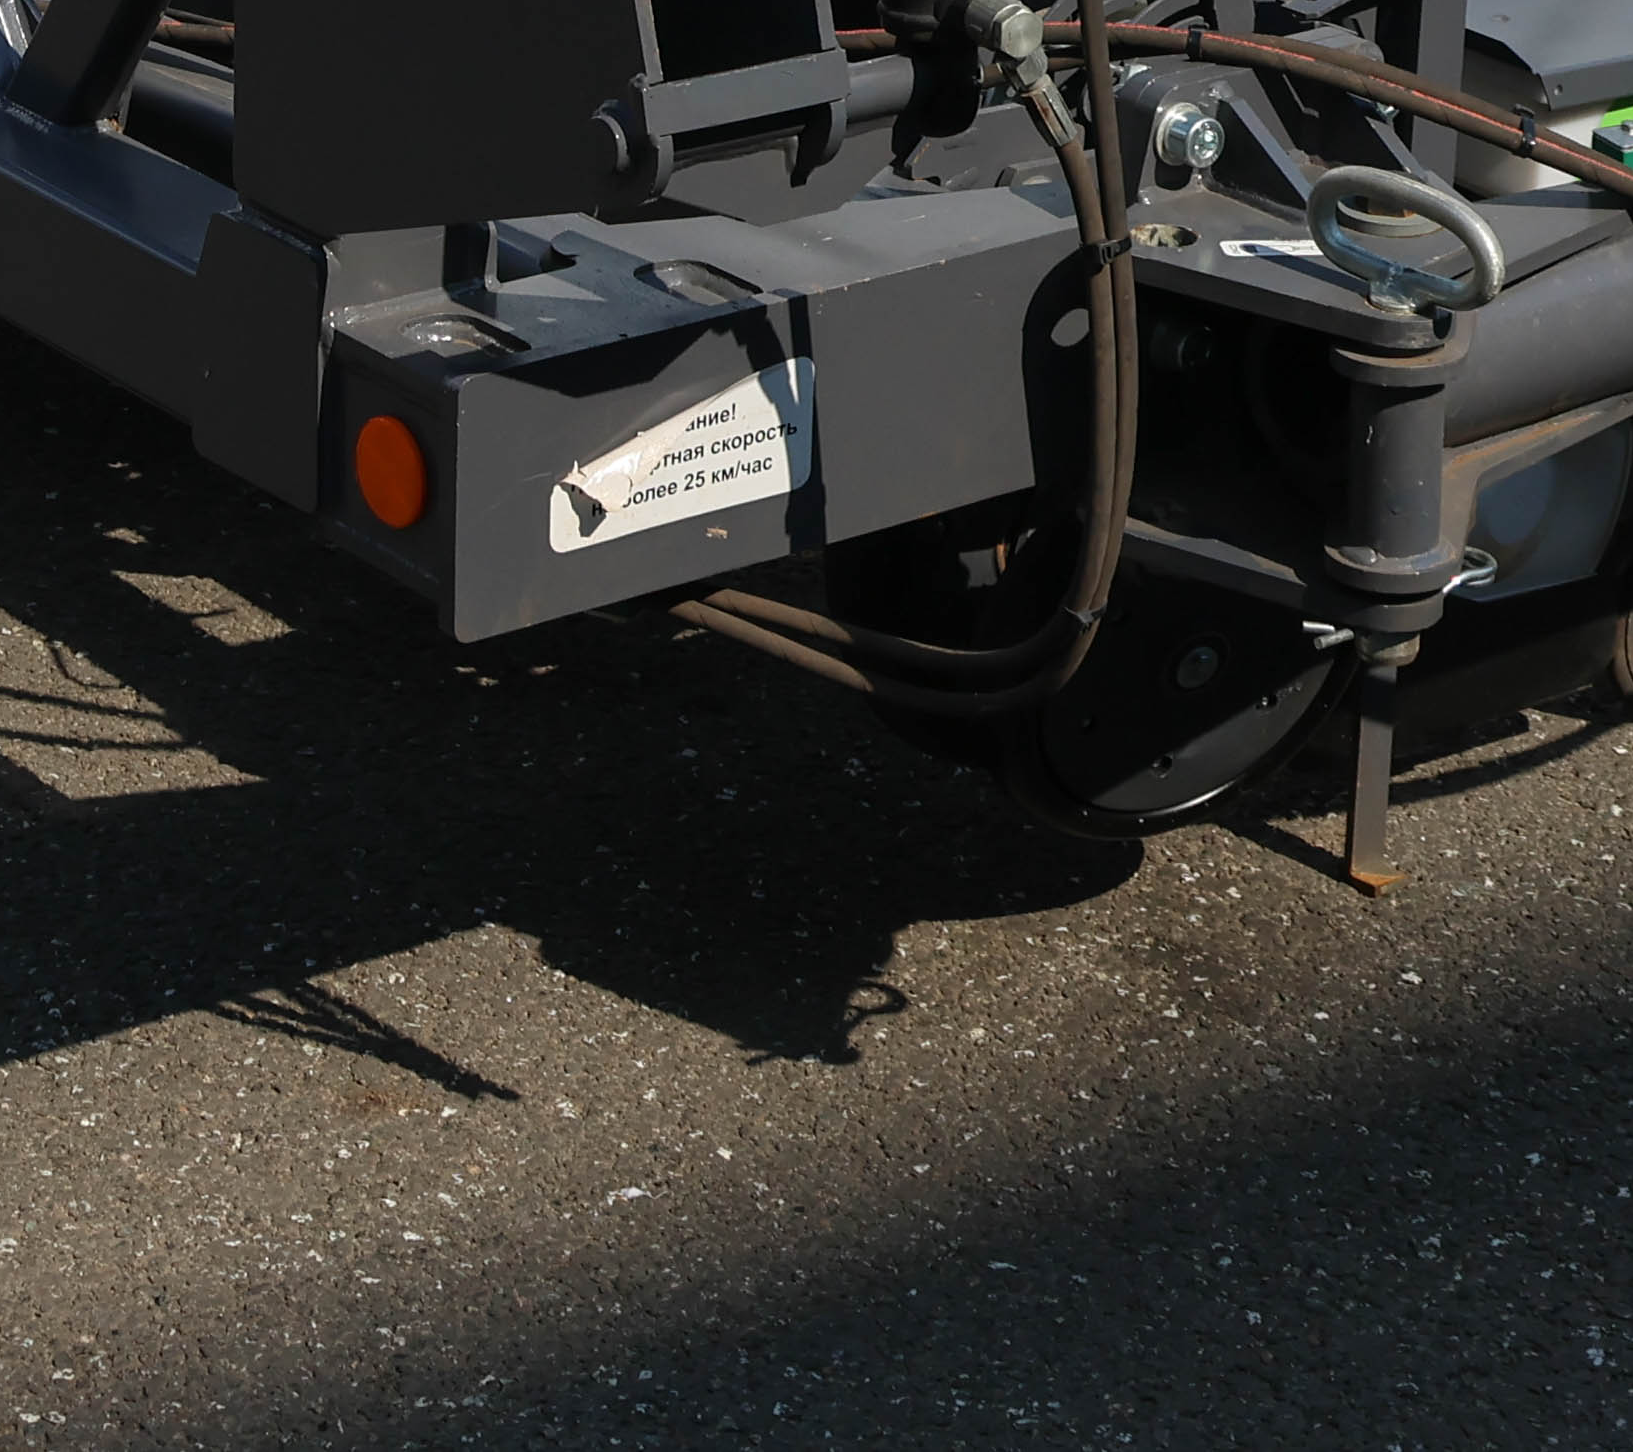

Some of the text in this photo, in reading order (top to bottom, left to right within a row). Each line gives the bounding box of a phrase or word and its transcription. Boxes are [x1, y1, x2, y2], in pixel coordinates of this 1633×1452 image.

[710, 422, 798, 455] скорость
[683, 470, 706, 492] 25
[711, 456, 774, 485] км/час
